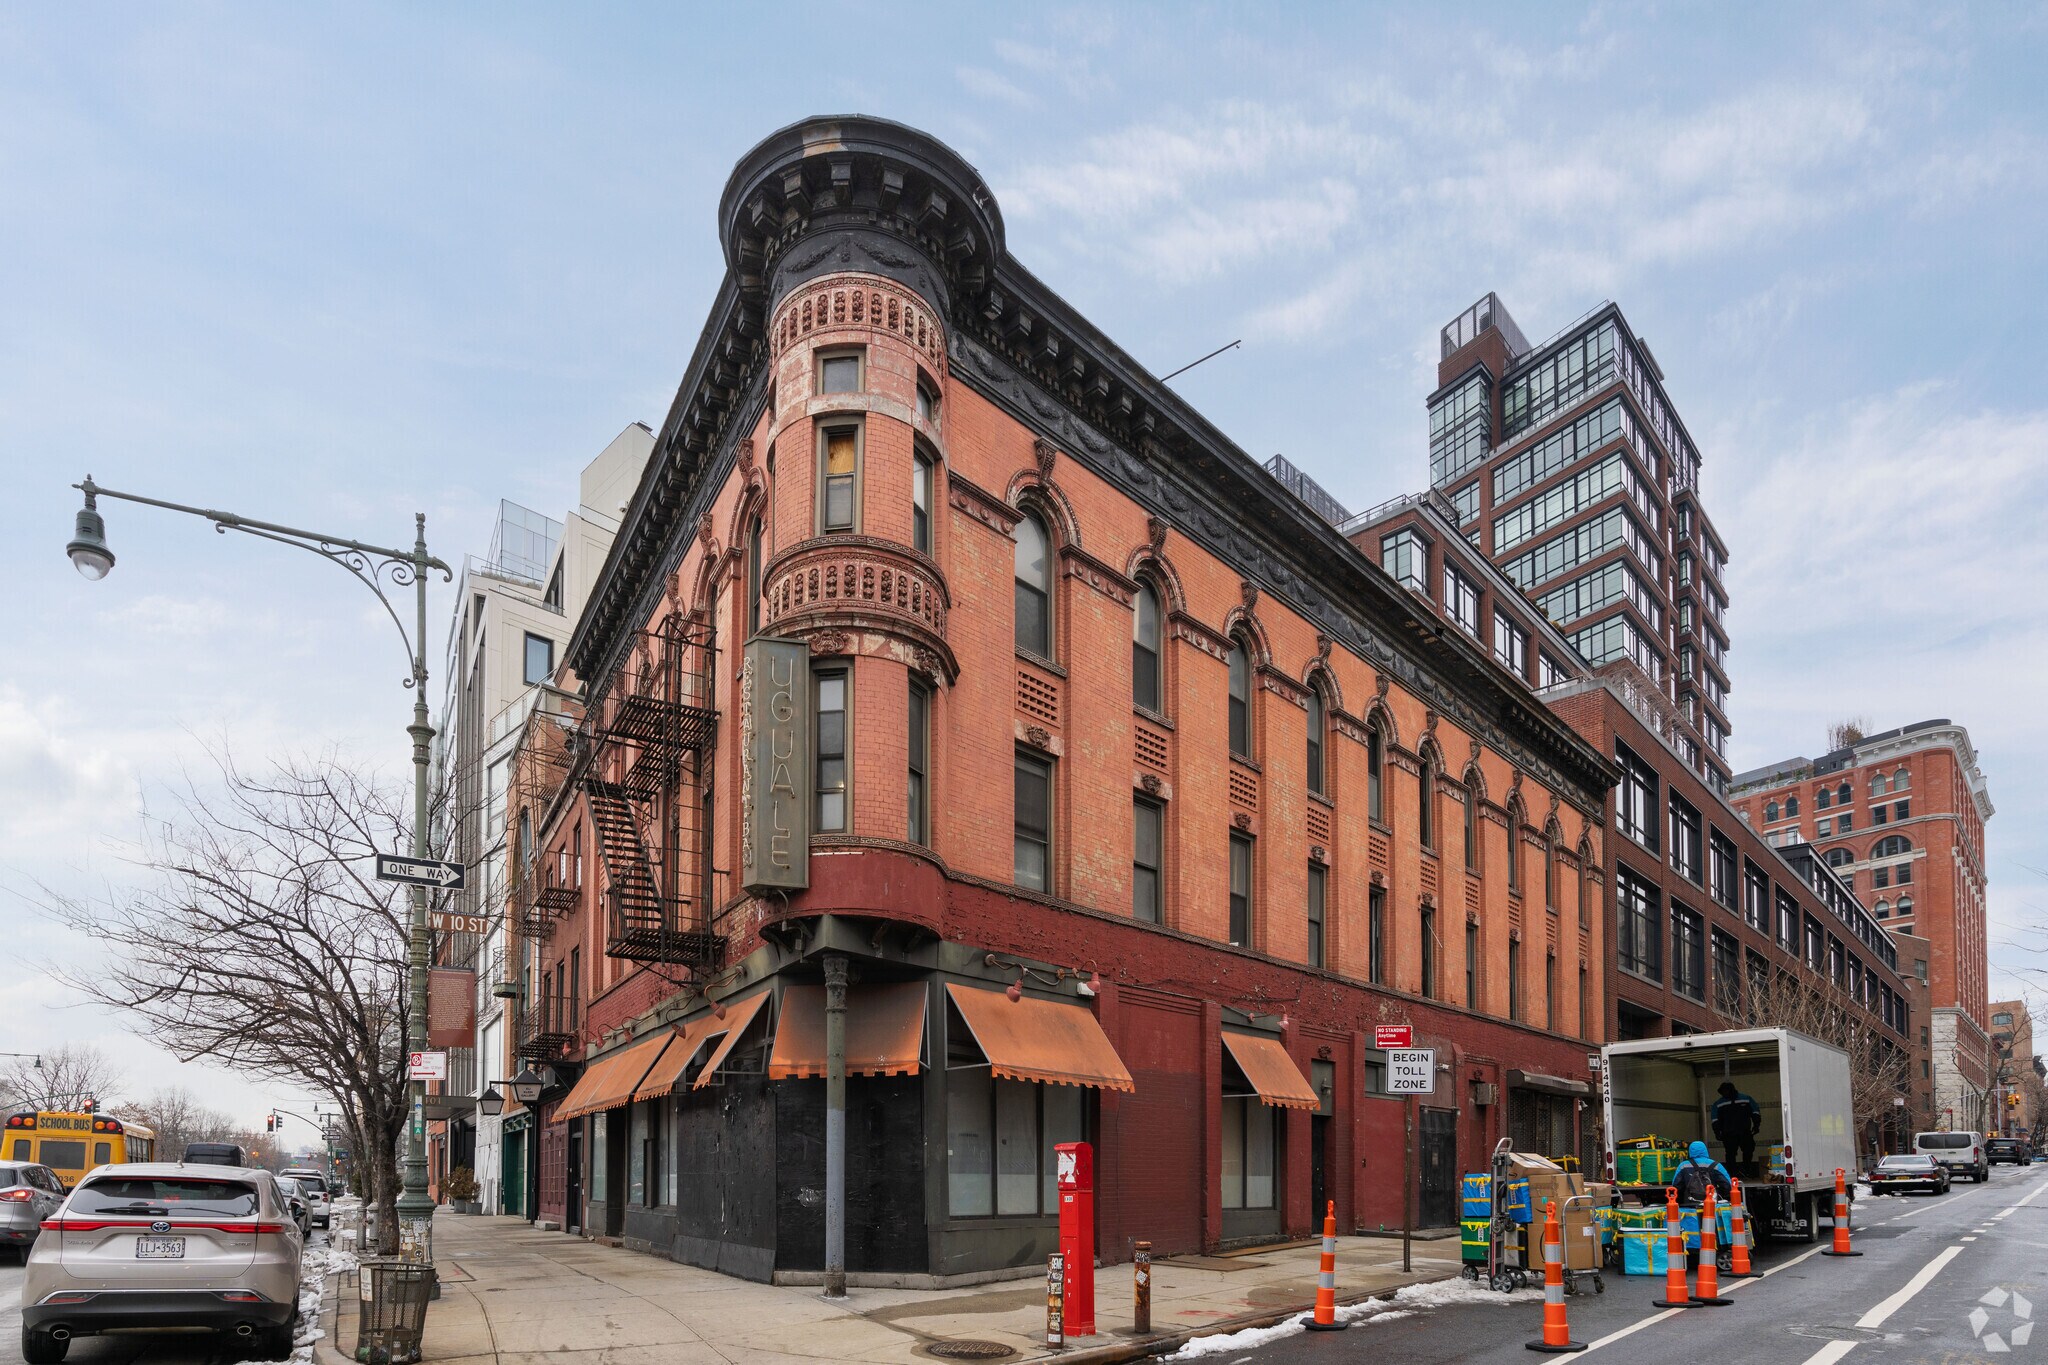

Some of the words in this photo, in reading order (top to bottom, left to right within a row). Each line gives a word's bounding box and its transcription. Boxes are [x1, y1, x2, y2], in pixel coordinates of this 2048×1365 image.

[771, 656, 796, 869] UGUALE
[390, 863, 415, 876] ONE
[427, 868, 452, 880] WAY
[432, 913, 444, 928] W
[450, 915, 464, 931] 10
[468, 917, 486, 933] ST
[1393, 1053, 1429, 1062] BEGIN
[1395, 1067, 1426, 1075] TOLL
[1394, 1080, 1426, 1088] ZONE
[1602, 1059, 1610, 1103] 914440
[40, 1116, 72, 1129] SCHOOL
[73, 1119, 90, 1131] BUS
